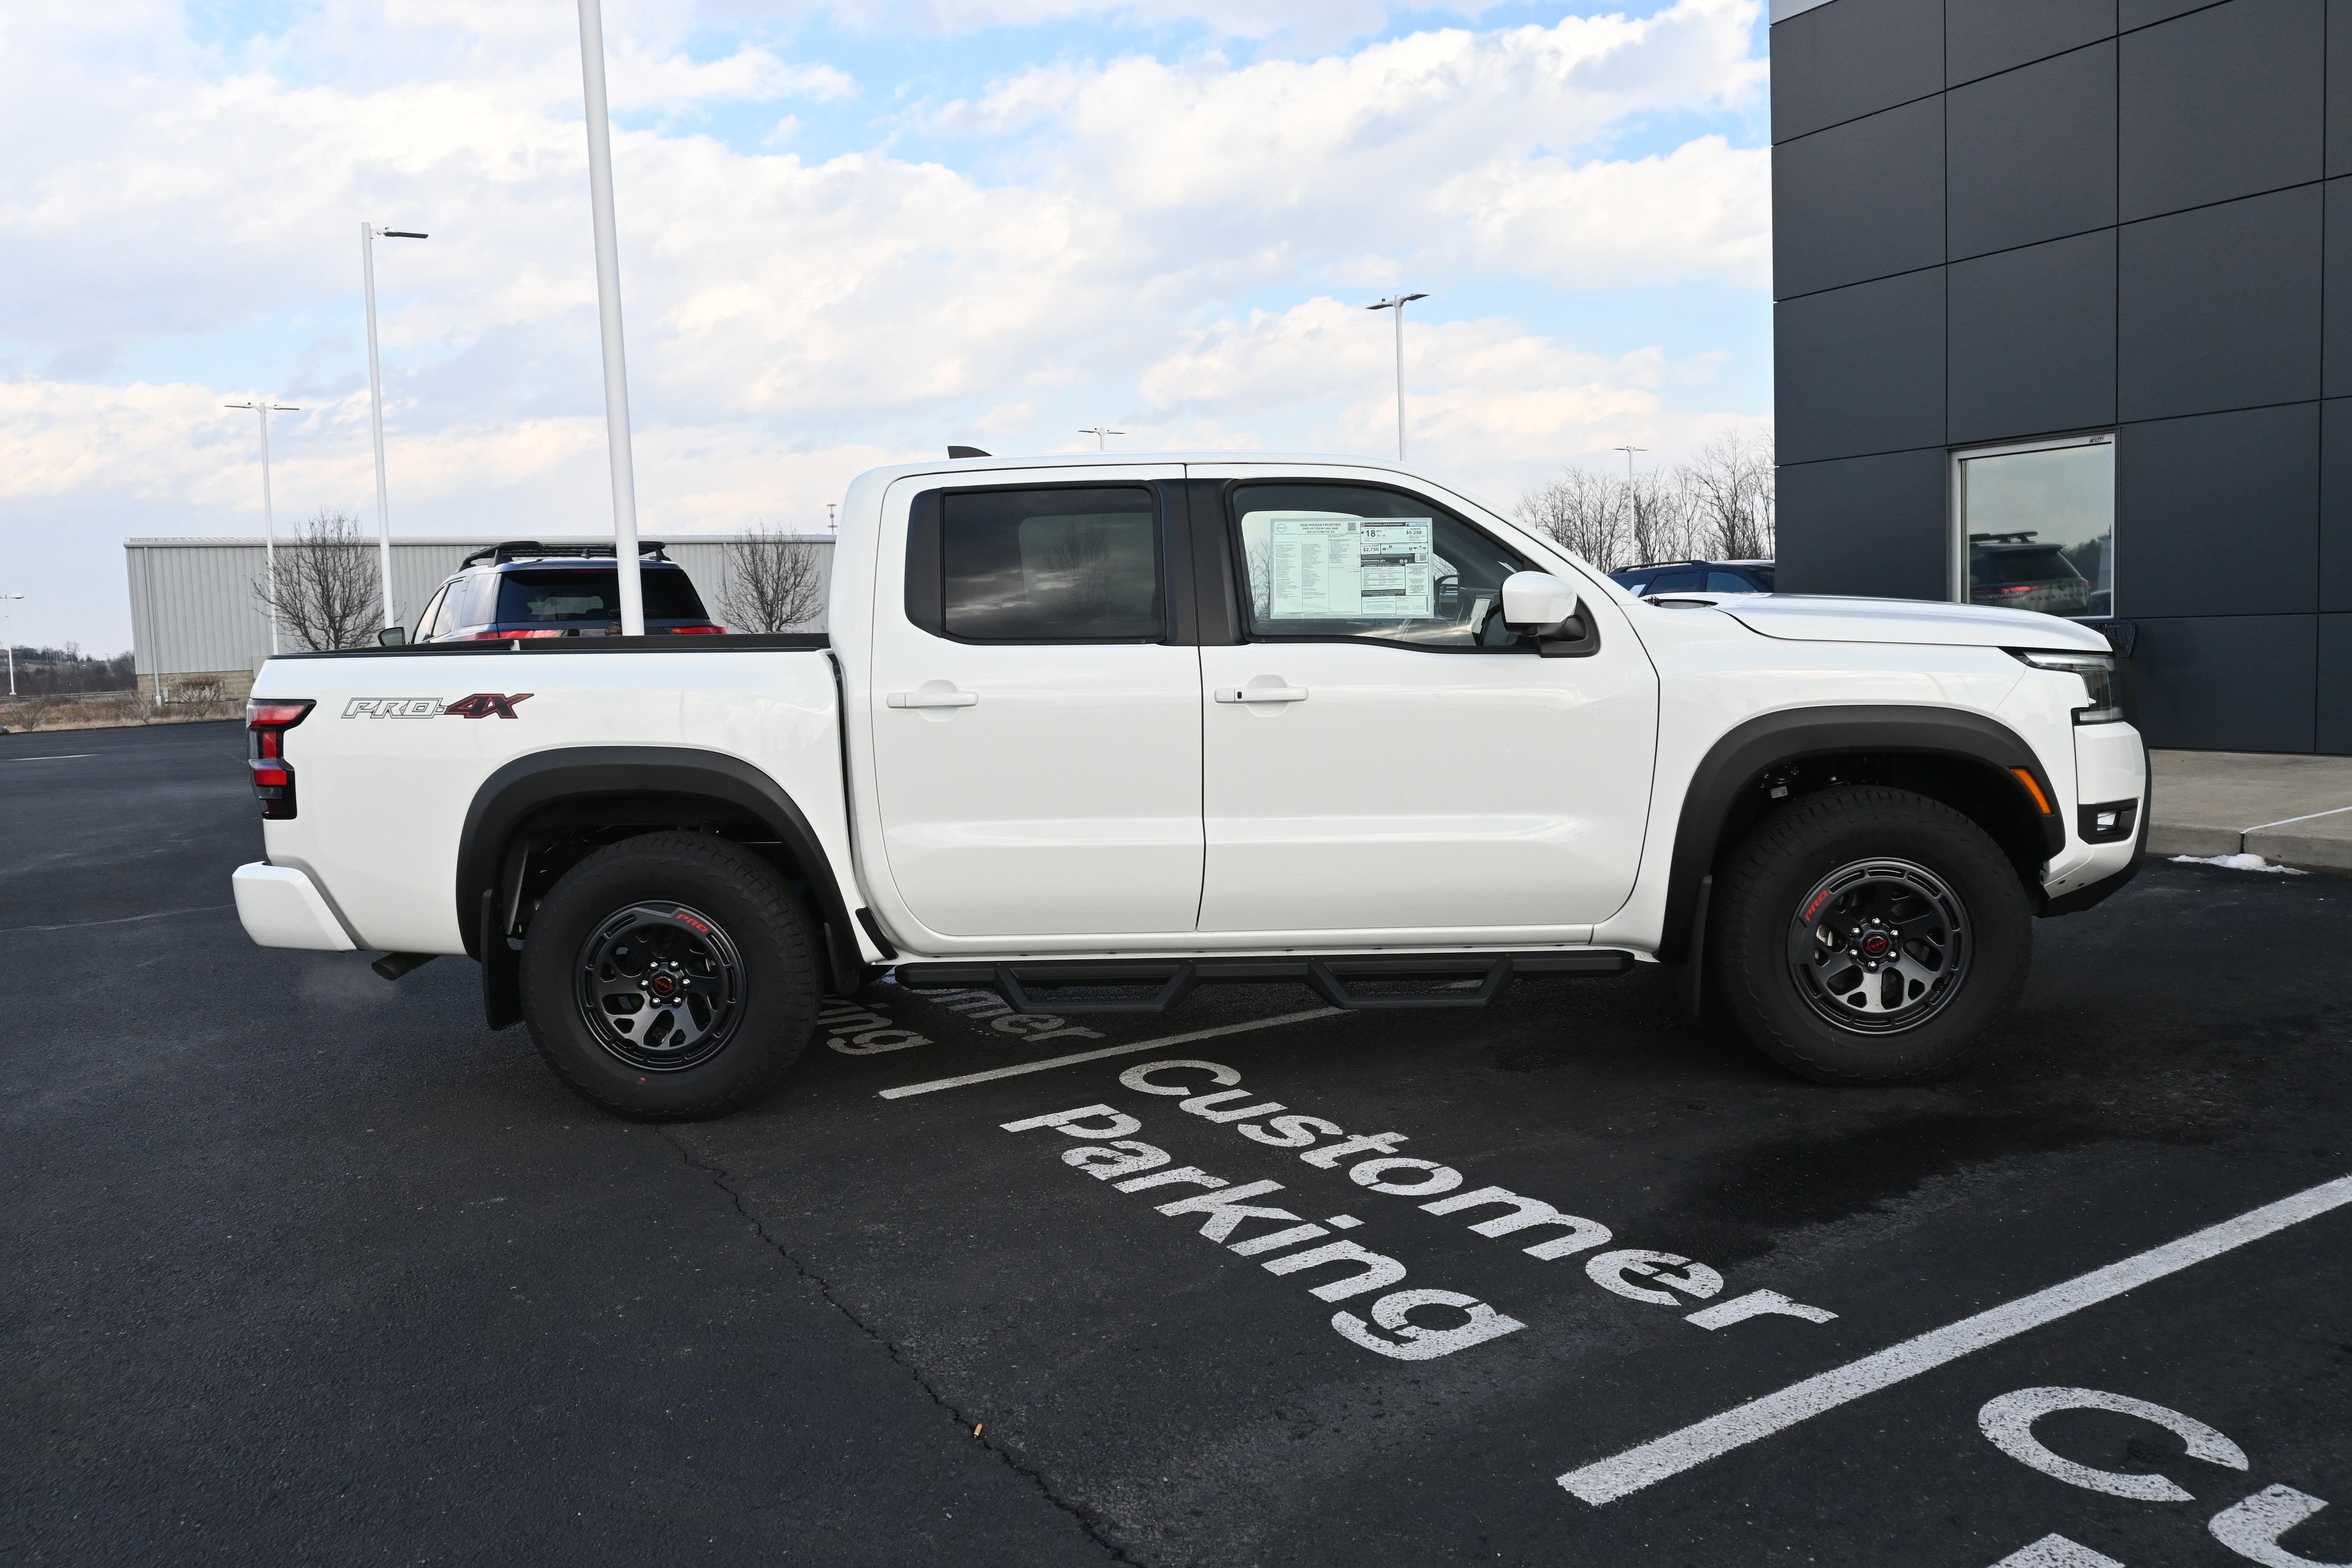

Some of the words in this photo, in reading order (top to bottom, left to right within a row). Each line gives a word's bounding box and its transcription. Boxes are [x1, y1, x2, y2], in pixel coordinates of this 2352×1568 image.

[341, 693, 534, 719] PRO-4X
[1805, 890, 1828, 921] PRO
[676, 914, 709, 932] PRO
[1119, 1061, 1839, 1331] Customer
[999, 1103, 1527, 1361] Parking
